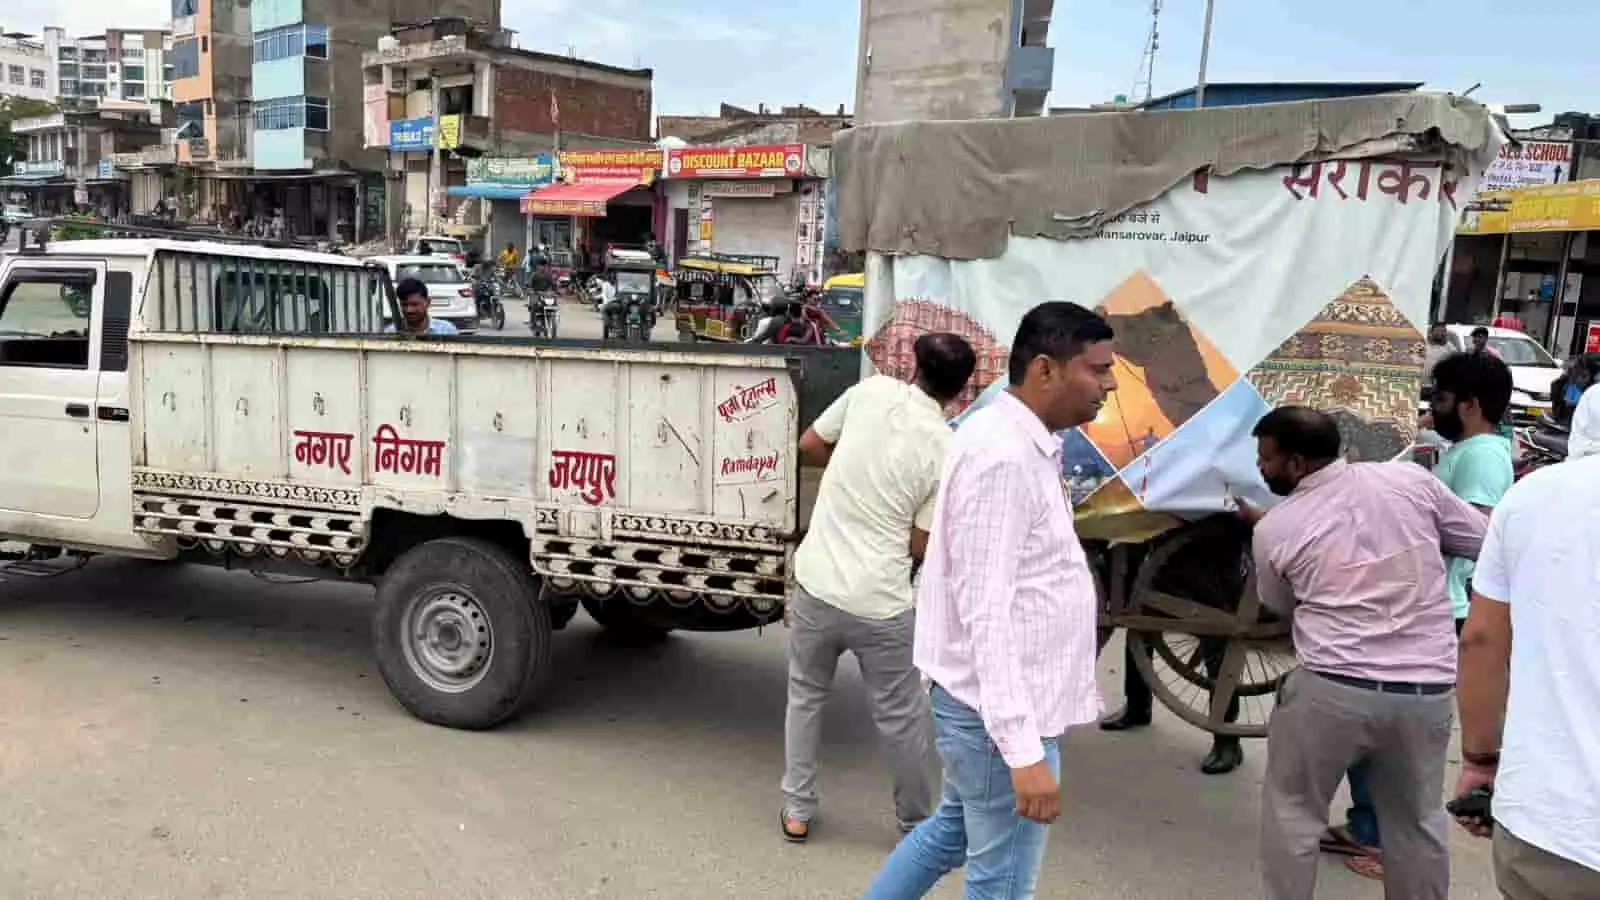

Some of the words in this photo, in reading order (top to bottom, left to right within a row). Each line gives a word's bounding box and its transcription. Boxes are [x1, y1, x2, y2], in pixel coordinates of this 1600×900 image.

[682, 152, 736, 169] DISCOUNT
[737, 151, 785, 168] BAZAAR
[1526, 143, 1569, 161] SCHOOL
[1128, 209, 1148, 224] बजे
[1150, 209, 1161, 224] से
[1169, 231, 1210, 246] Jaipur
[294, 430, 354, 475] नगर
[372, 424, 446, 477] निगम
[549, 450, 617, 505] जयपुर
[721, 449, 779, 480] Ramdayal
